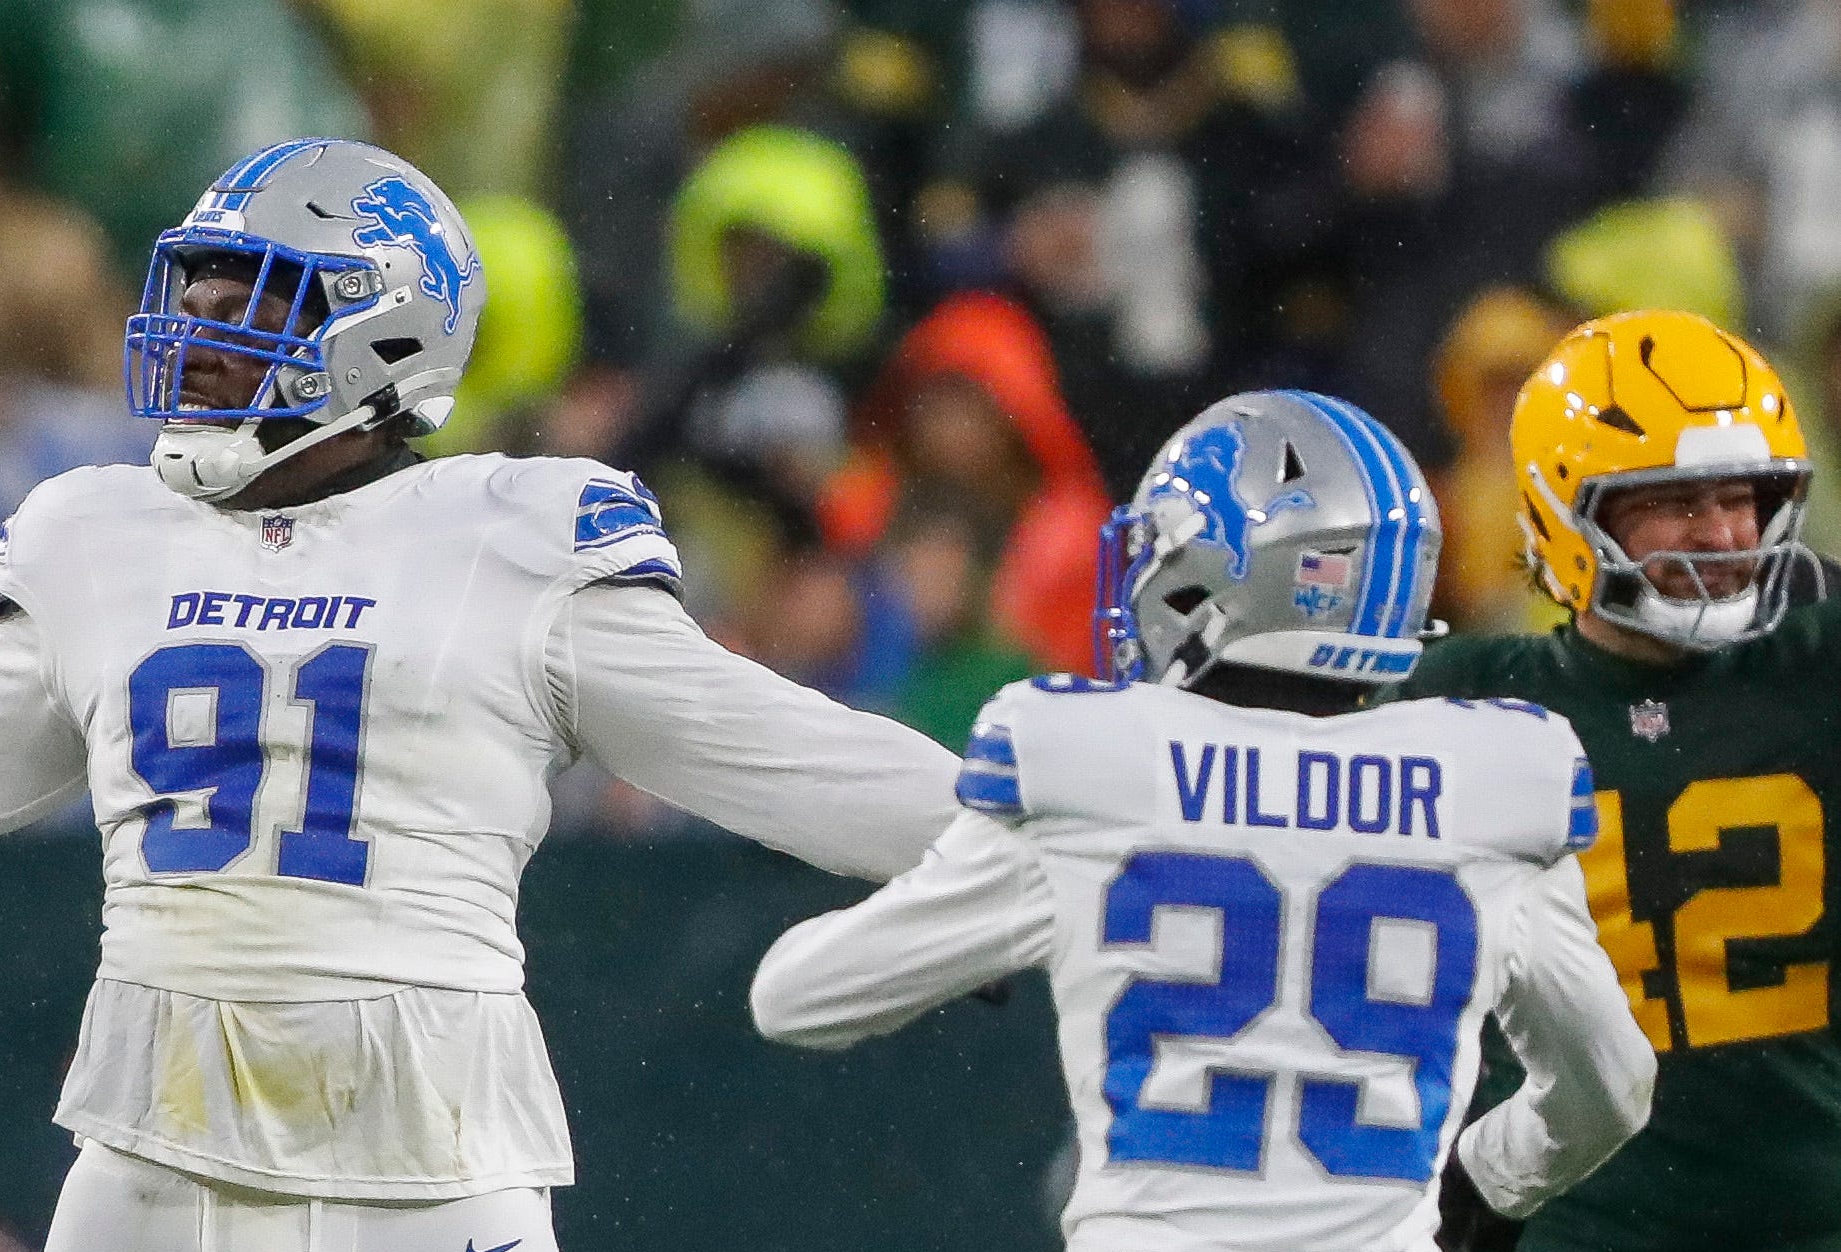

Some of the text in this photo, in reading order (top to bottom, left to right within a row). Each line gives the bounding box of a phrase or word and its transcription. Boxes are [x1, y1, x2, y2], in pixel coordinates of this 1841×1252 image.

[264, 527, 290, 544] NFL
[166, 592, 376, 631] DETROIT
[127, 637, 376, 888] 91
[1169, 740, 1442, 839] VILDOR
[1098, 846, 1482, 1192] 29
